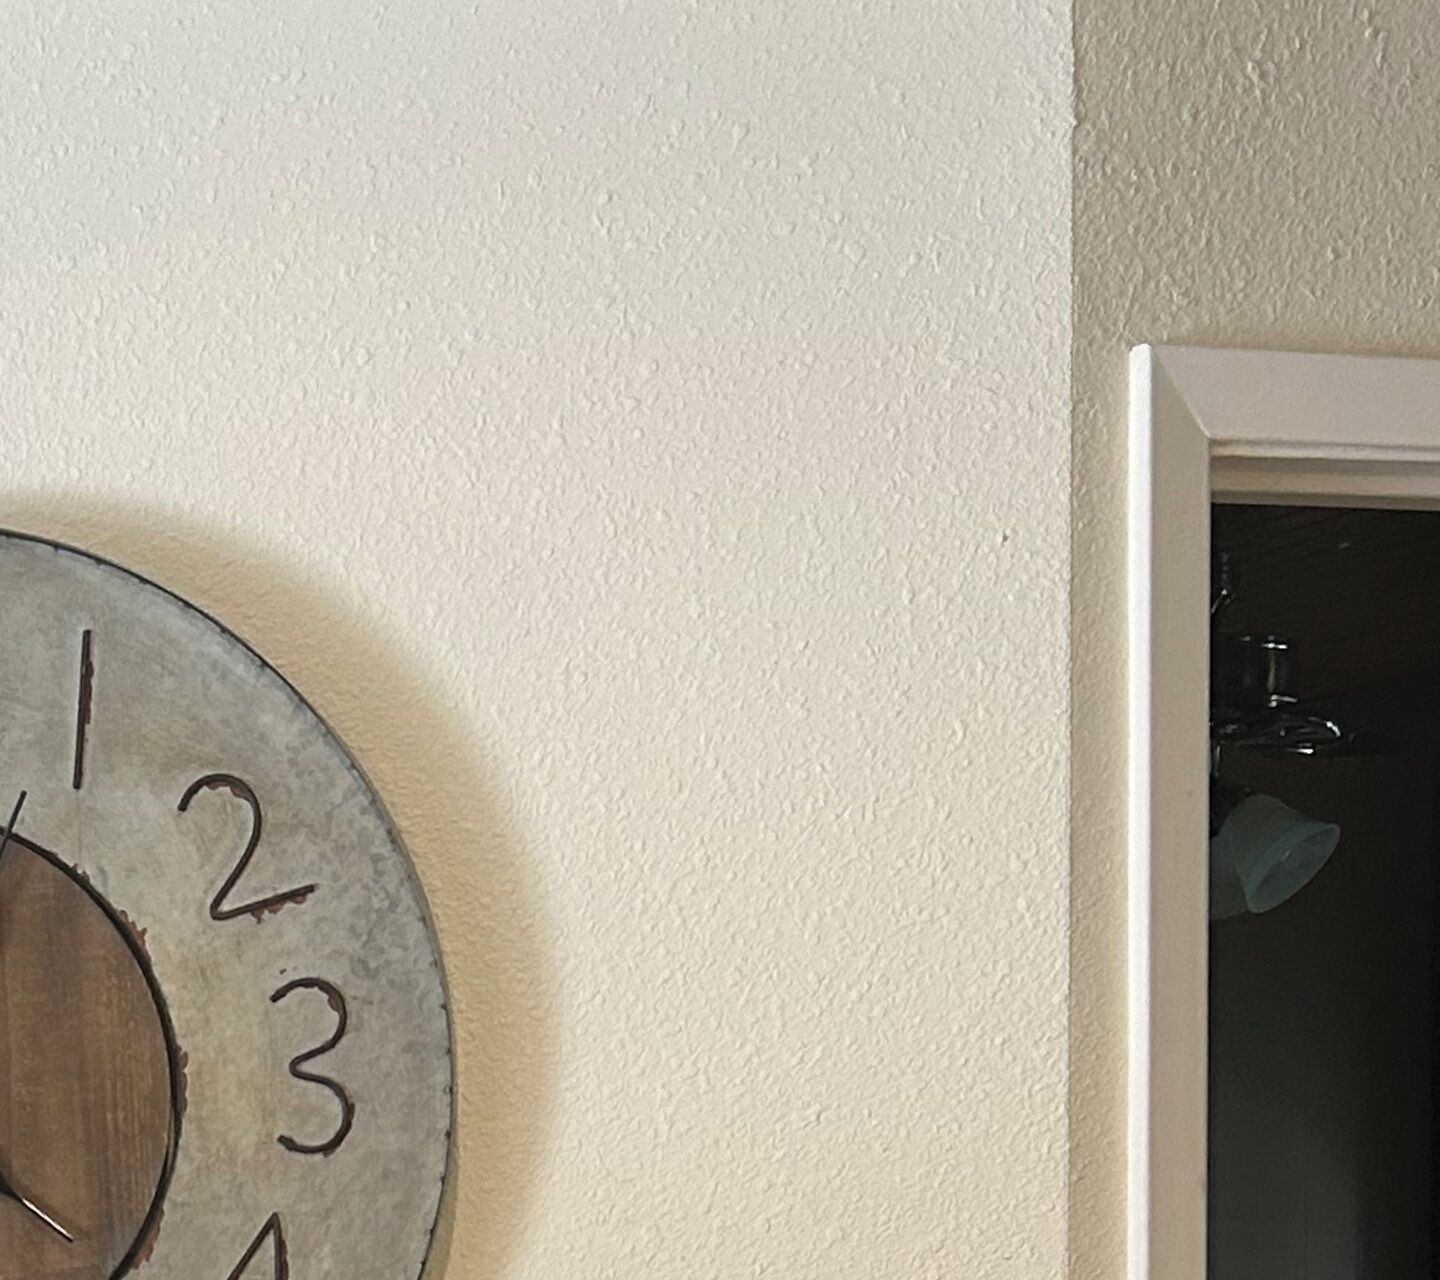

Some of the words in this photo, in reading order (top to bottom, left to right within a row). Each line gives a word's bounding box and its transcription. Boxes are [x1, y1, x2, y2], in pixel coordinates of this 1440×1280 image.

[71, 627, 93, 792] 1
[176, 772, 317, 922] 2
[270, 976, 355, 1157] 3
